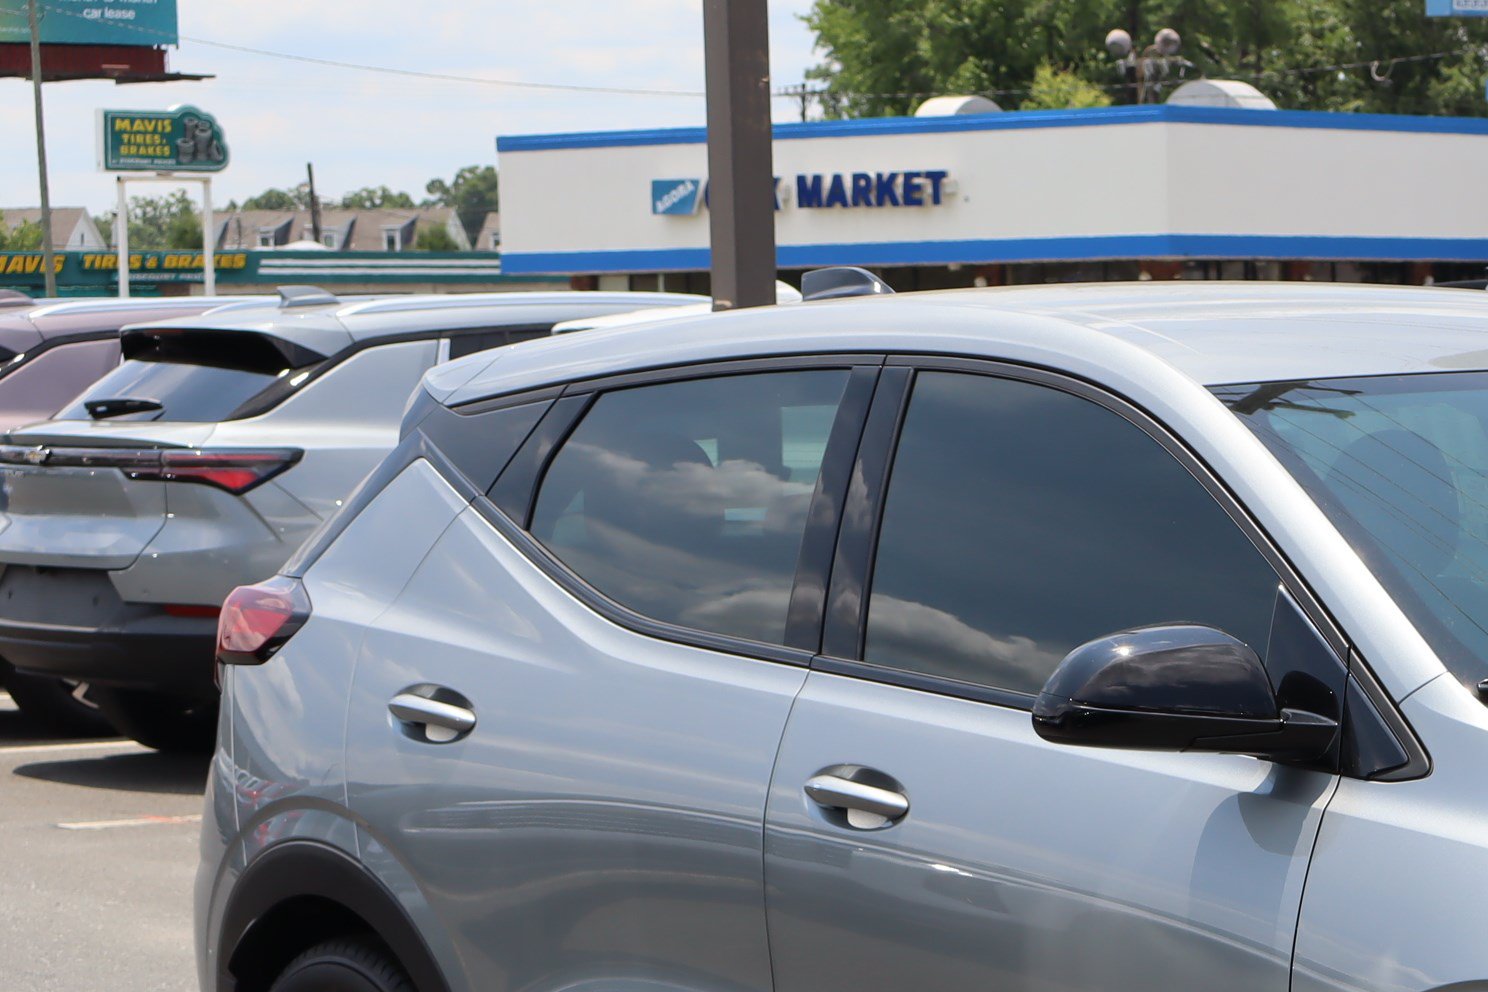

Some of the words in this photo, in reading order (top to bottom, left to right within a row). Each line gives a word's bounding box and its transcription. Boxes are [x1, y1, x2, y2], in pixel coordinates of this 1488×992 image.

[83, 8, 102, 20] car
[104, 6, 136, 20] lease
[115, 118, 172, 133] MAVIS
[121, 133, 161, 144] TIRES
[119, 145, 171, 157] BRAKES
[796, 170, 949, 209] MARKET
[83, 253, 143, 269] TIRS
[146, 255, 158, 269] &
